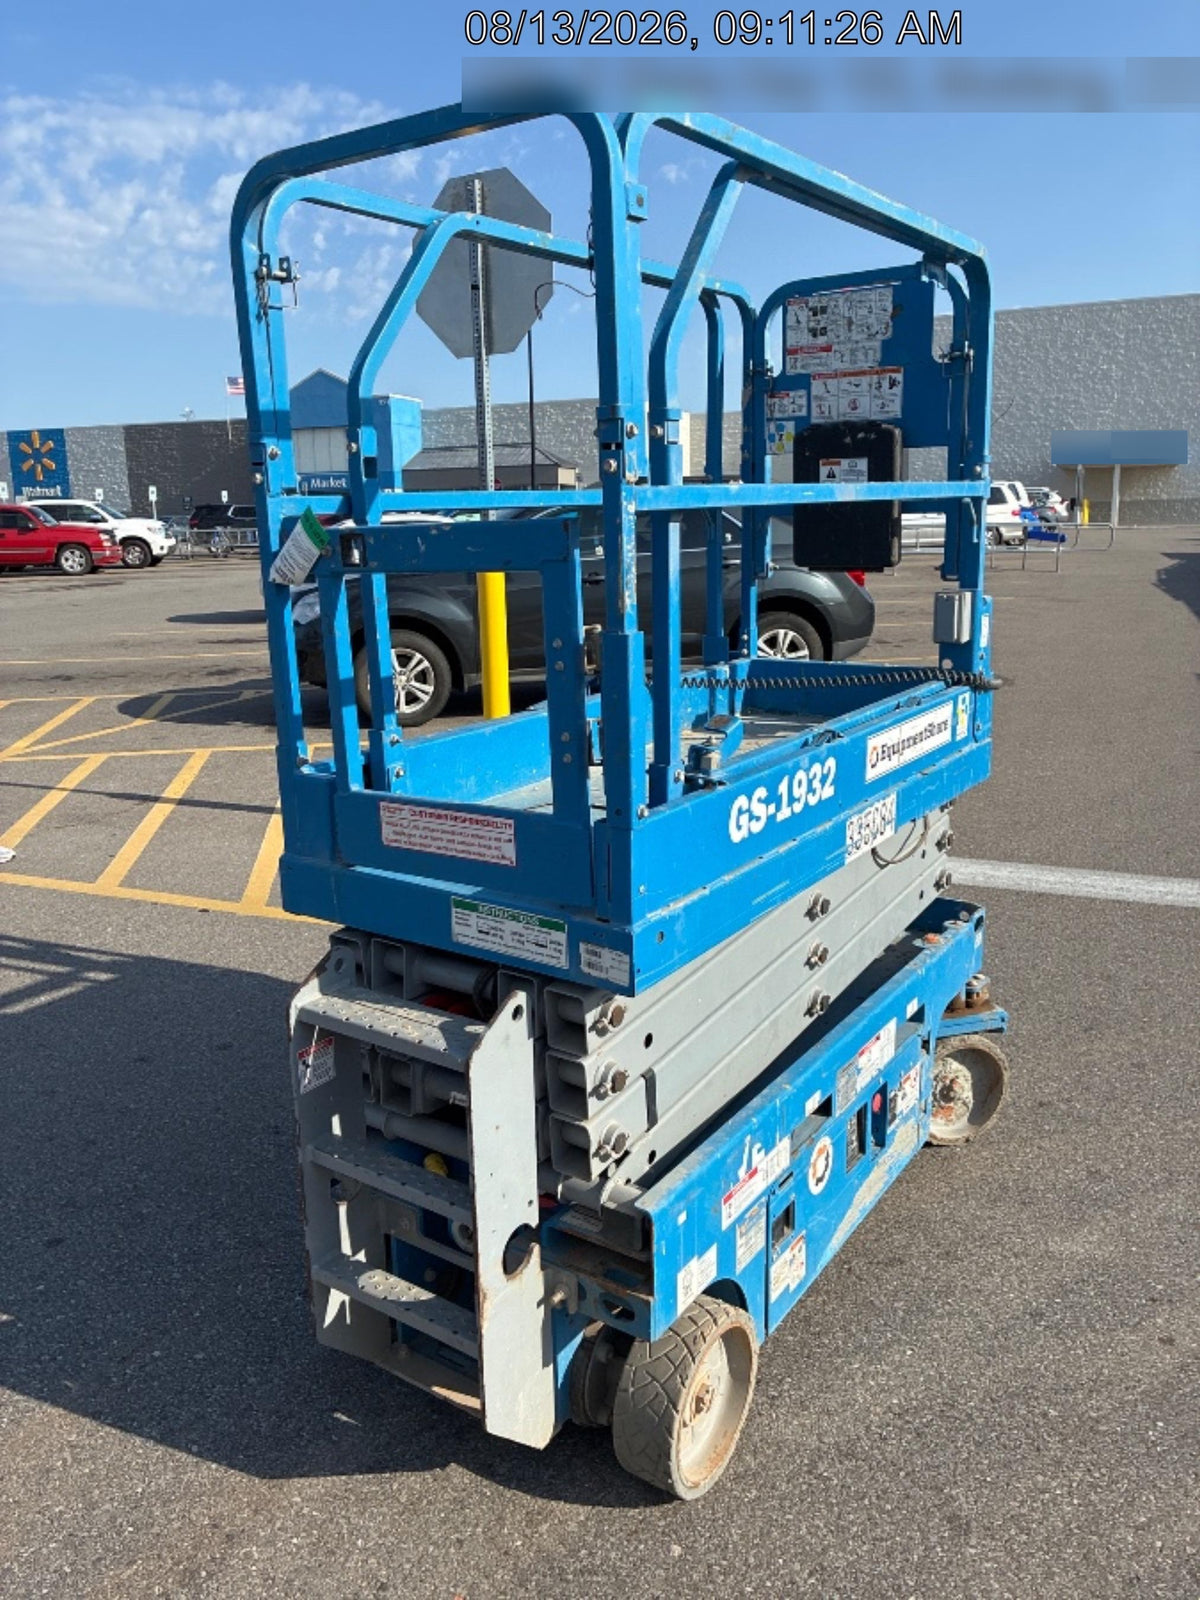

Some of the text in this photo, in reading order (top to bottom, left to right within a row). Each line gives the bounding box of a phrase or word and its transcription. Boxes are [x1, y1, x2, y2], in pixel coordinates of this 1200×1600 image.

[21, 484, 62, 497] Walmart
[310, 477, 347, 488] Market
[880, 717, 950, 761] EquipmentShare
[728, 756, 837, 843] GS-1932
